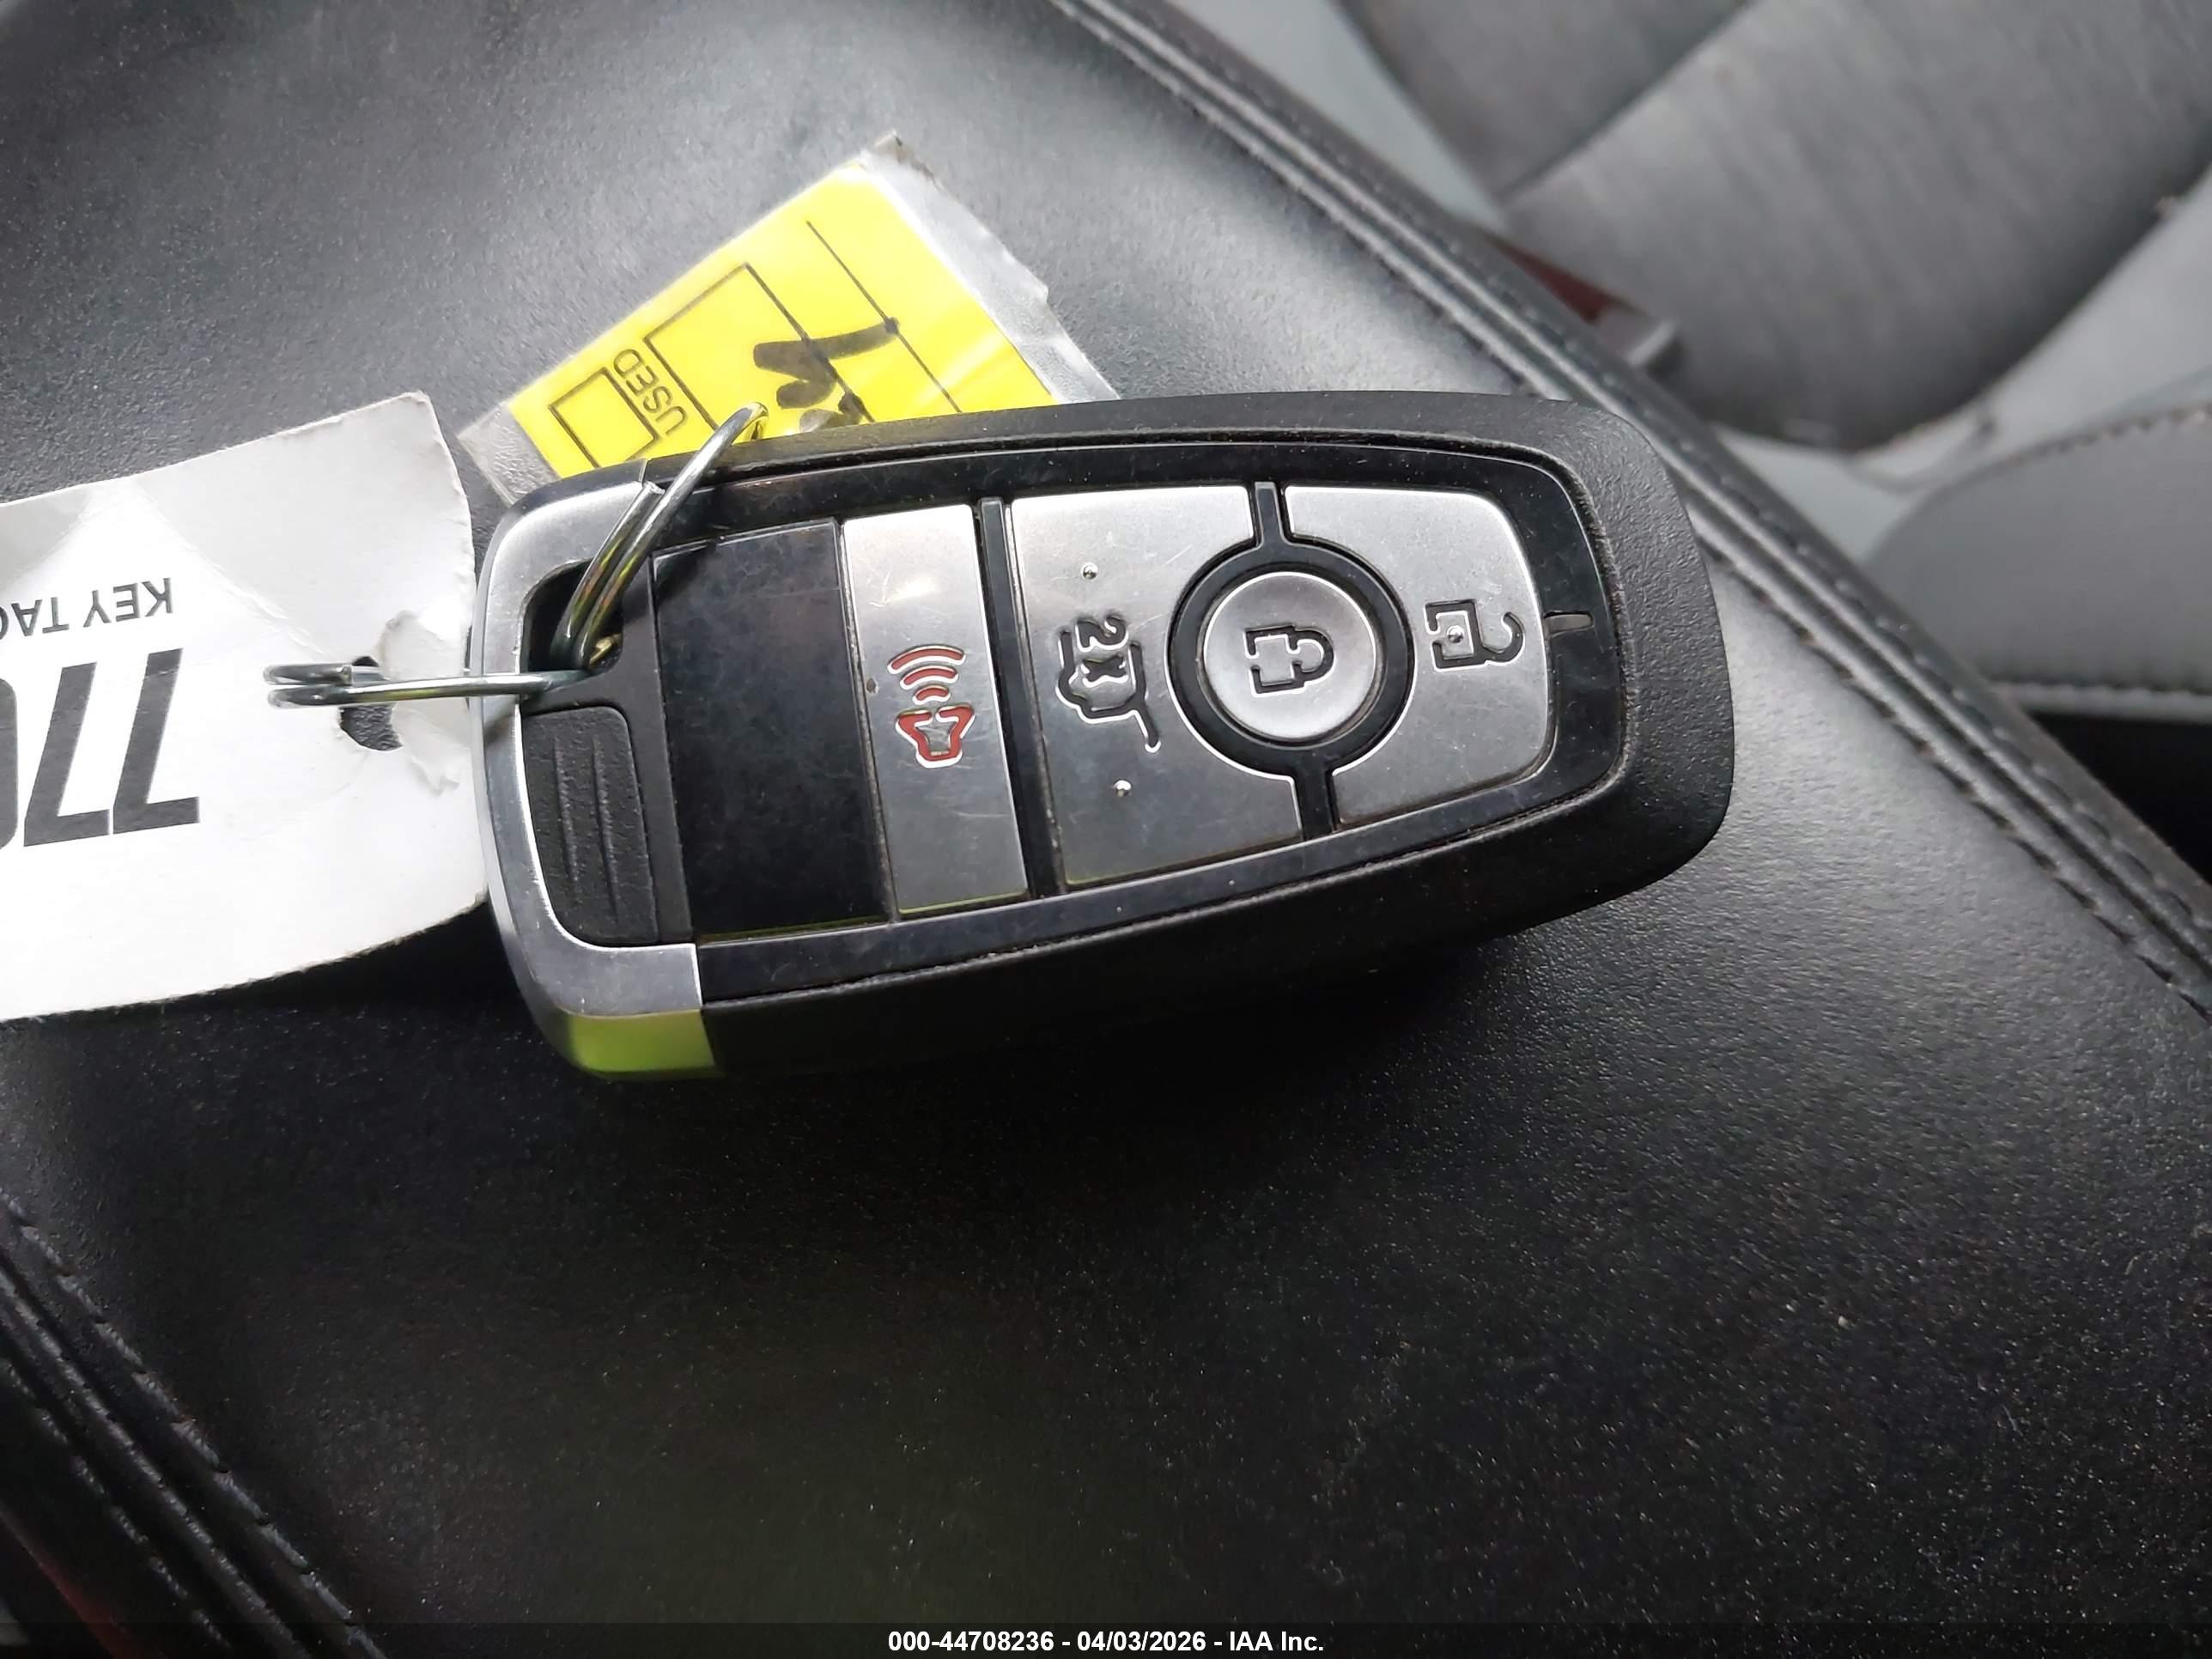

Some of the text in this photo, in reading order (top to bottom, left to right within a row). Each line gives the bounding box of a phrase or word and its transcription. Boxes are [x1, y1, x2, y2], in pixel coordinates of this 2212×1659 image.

[612, 348, 689, 437] USED
[0, 577, 174, 641] KEY TA
[0, 647, 200, 848] 77
